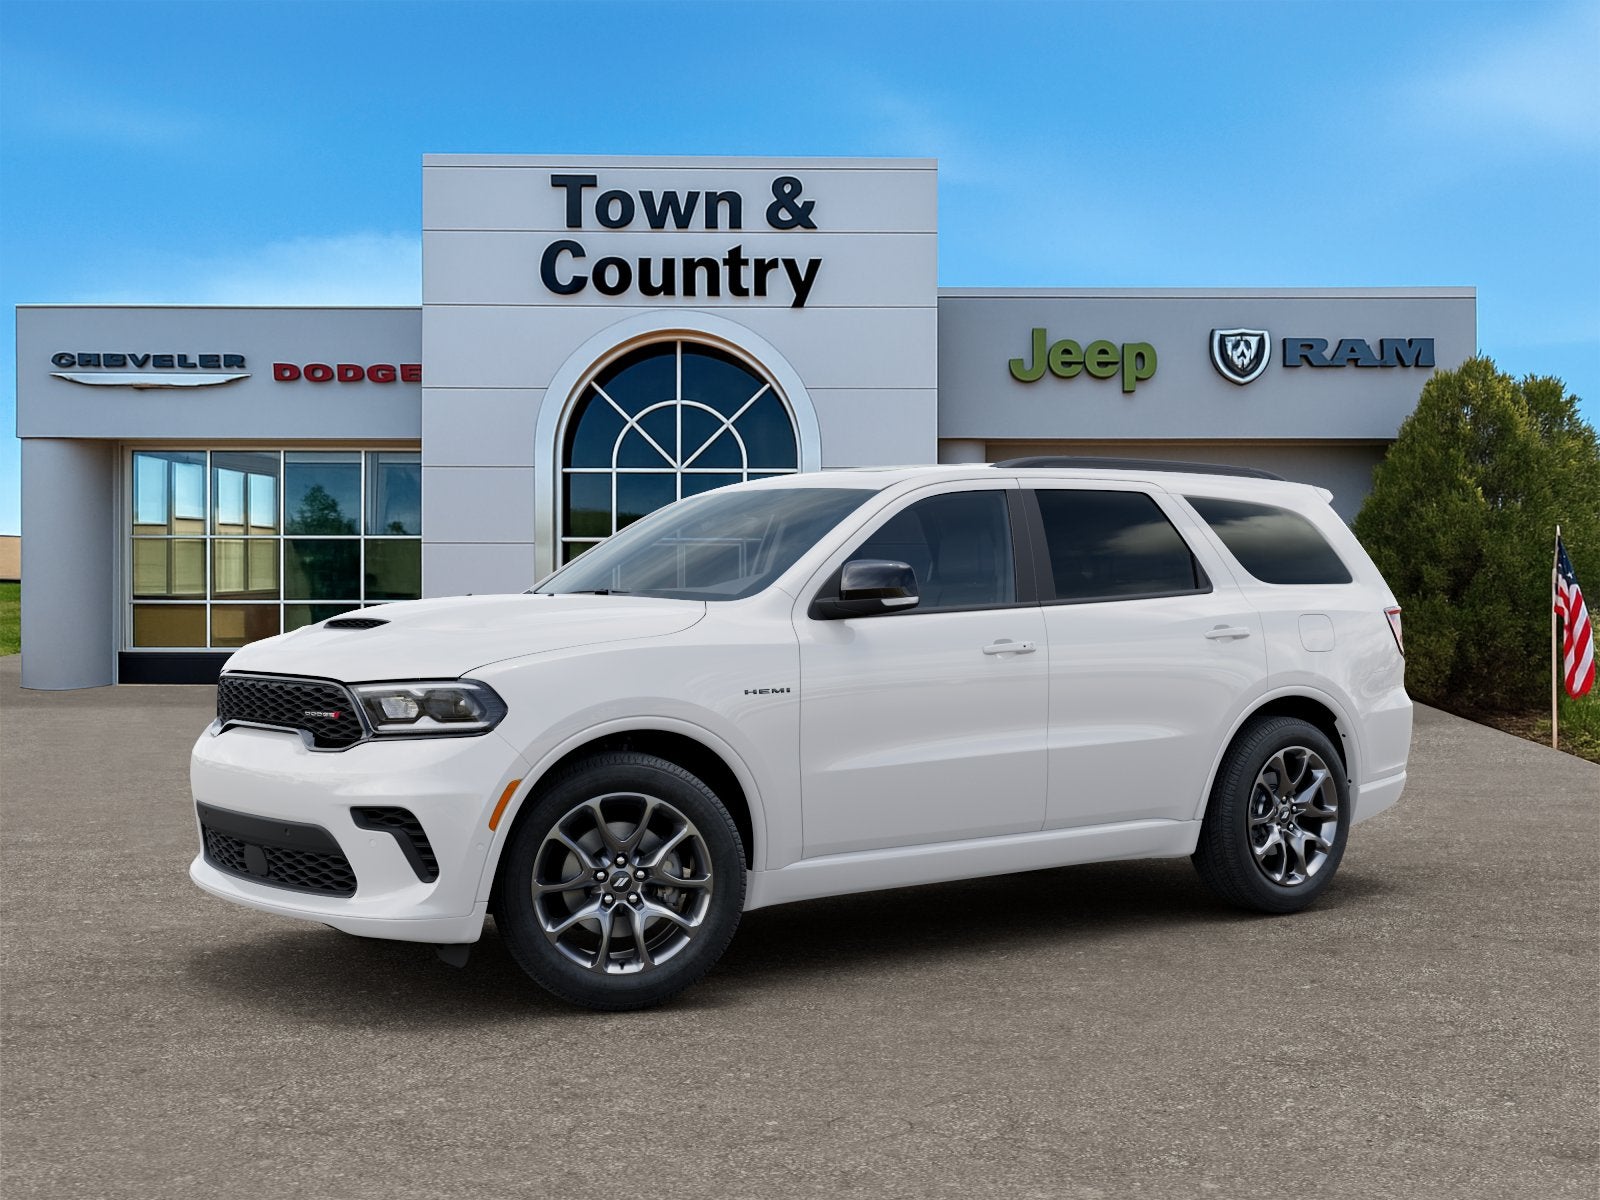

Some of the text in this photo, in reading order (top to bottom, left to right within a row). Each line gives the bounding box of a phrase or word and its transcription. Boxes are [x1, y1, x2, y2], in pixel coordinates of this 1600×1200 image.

[550, 174, 818, 230] Town &
[540, 239, 822, 308] Country
[273, 363, 422, 383] DODGE
[1009, 328, 1157, 393] Jeep
[1283, 338, 1435, 367] RAM
[744, 687, 791, 695] HEMI
